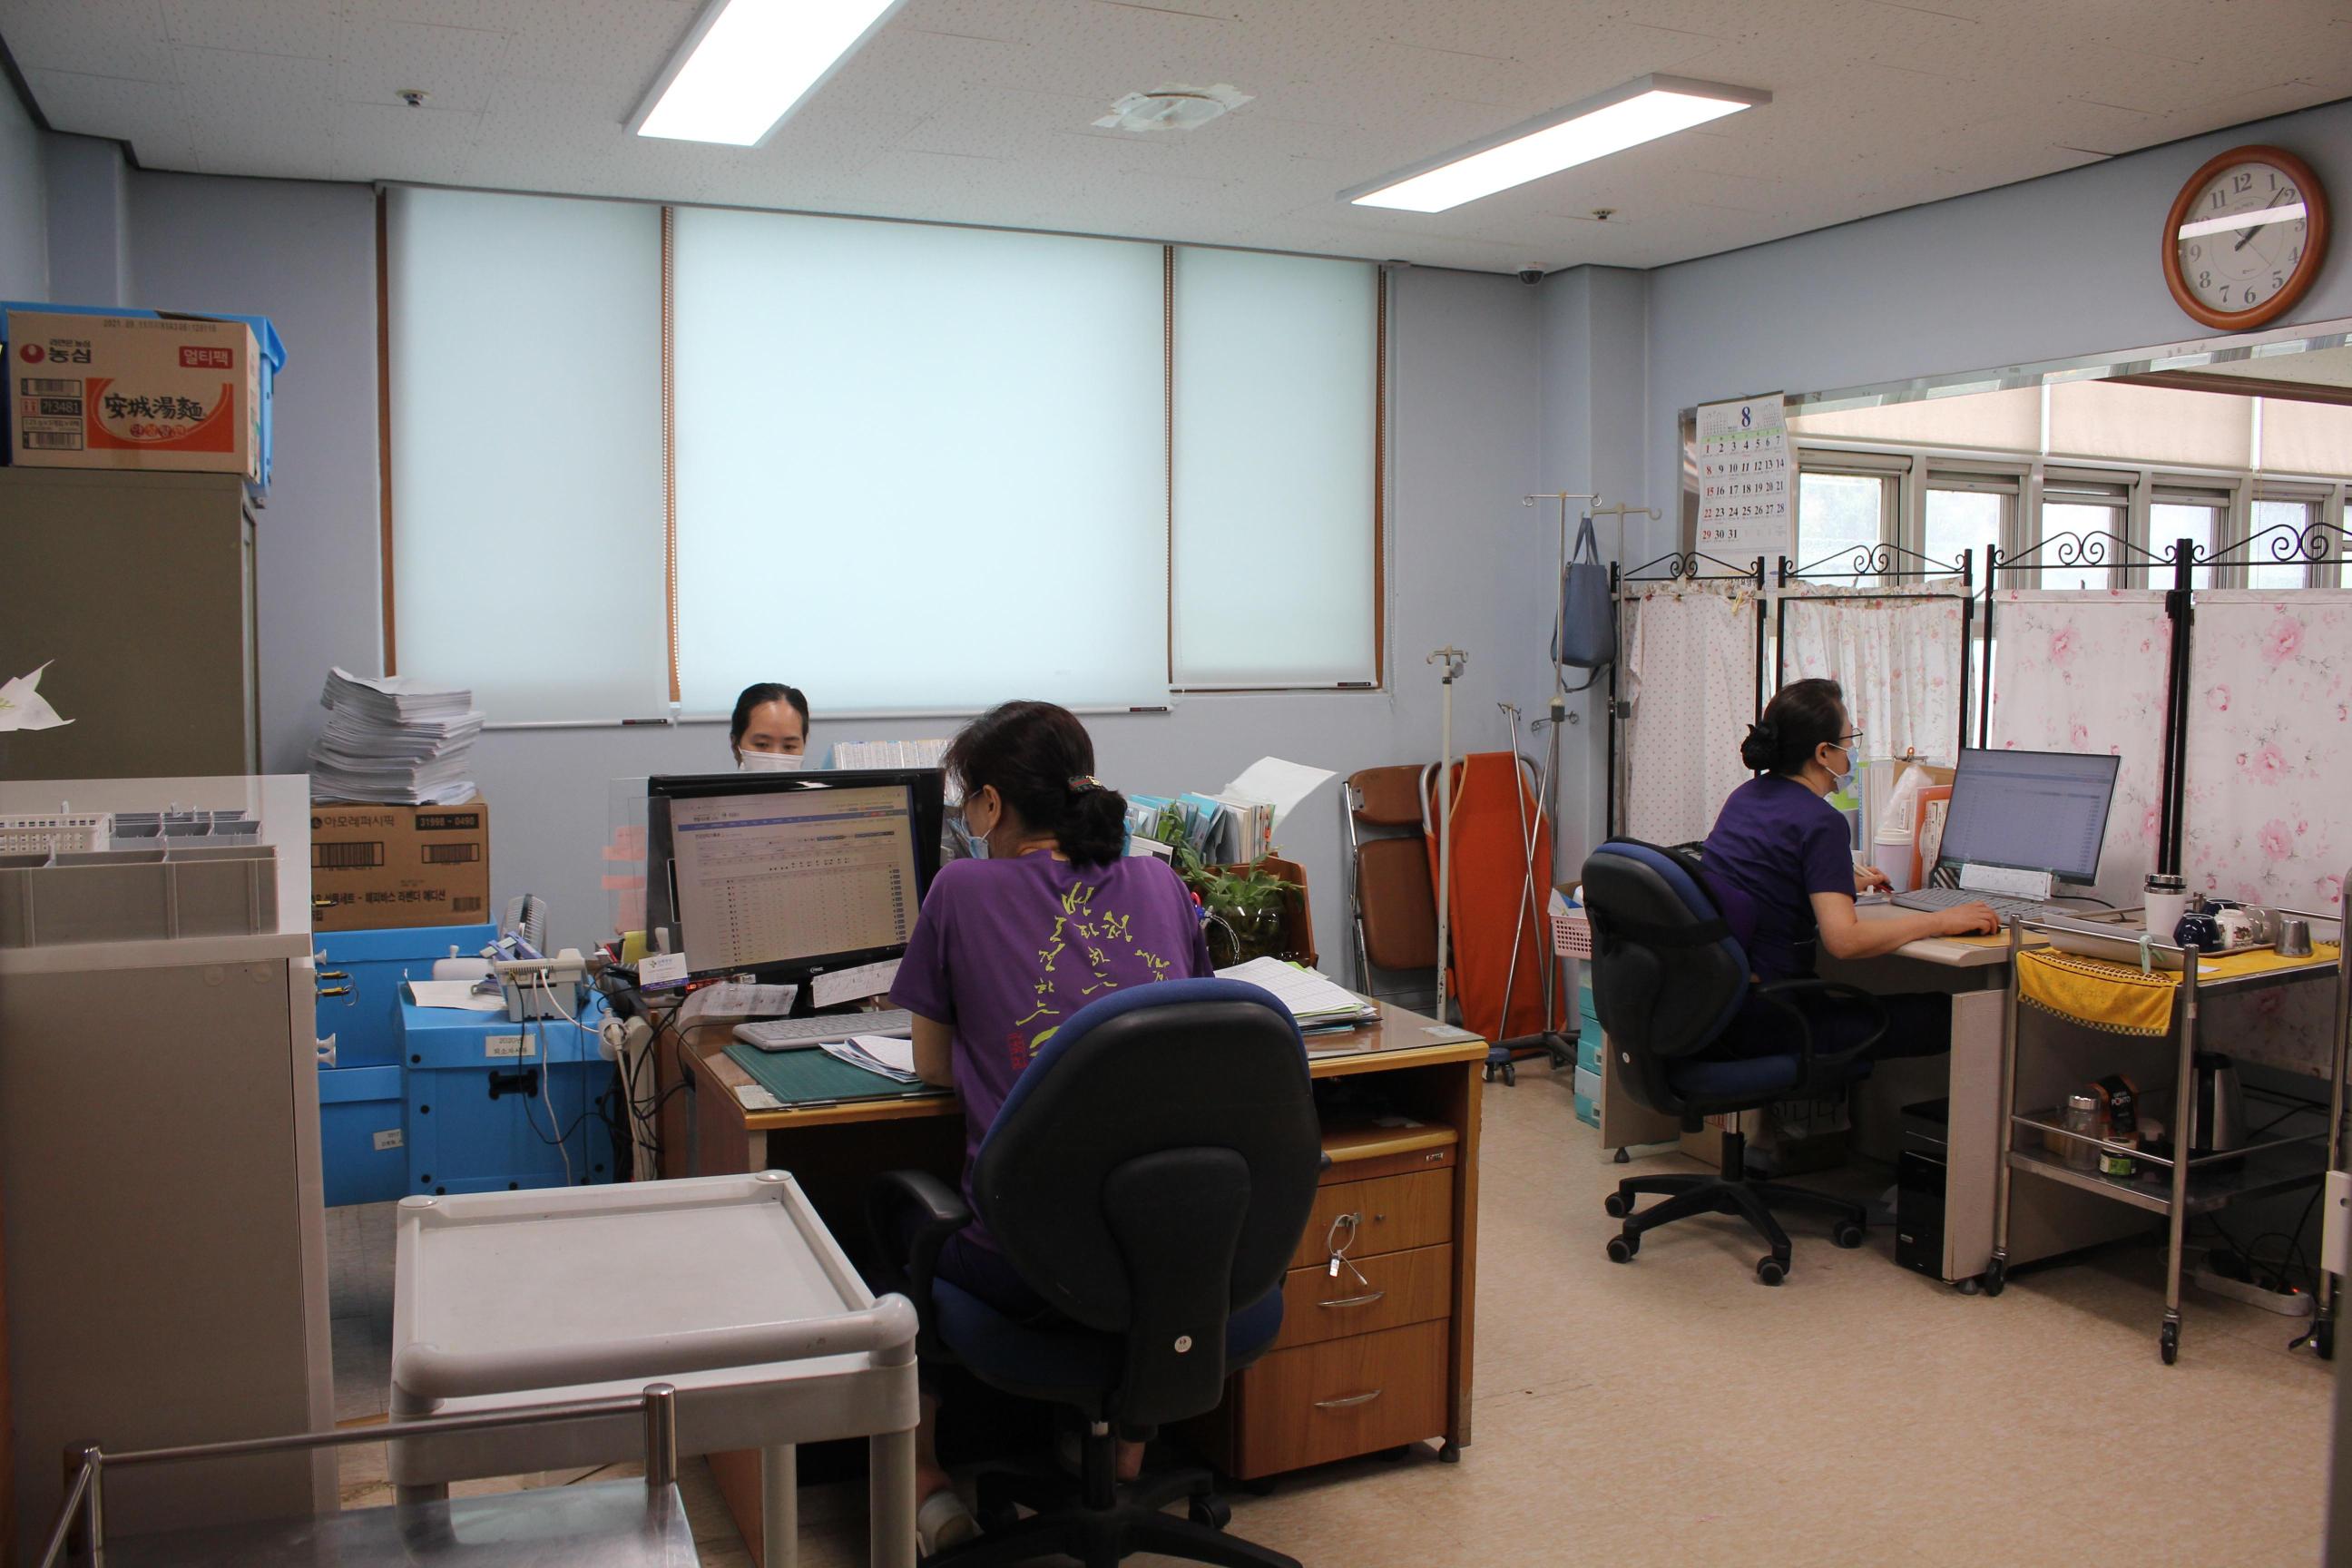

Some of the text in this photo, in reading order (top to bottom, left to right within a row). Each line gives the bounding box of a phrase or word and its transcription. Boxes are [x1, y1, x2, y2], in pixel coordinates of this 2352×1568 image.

[2233, 173, 2252, 194] 12
[2269, 173, 2276, 191] 1
[2211, 189, 2226, 211] 11
[2284, 189, 2296, 205] 2
[2295, 217, 2306, 232] 3
[2190, 245, 2201, 261] 9
[2288, 247, 2298, 264] 4
[2199, 271, 2211, 289] 8
[2272, 270, 2283, 289] 5
[2220, 285, 2230, 302] 7
[2244, 286, 2256, 304] 6
[48, 347, 92, 364] 농심
[183, 348, 229, 366] 멀티팩
[43, 400, 80, 414] 가3481
[104, 393, 204, 422] 安城湯麵
[1741, 407, 1750, 427] 8
[1706, 436, 1780, 454] 1 2 3 4 5 6 7
[1707, 458, 1784, 475] 8 9 10 11 12 13 14
[1707, 481, 1784, 496] 15 16 17 18 19 20 21
[1704, 503, 1785, 518] 22 23 24 25 26 27 28
[1702, 529, 1738, 540] 29 30 31
[324, 815, 394, 828] 아모레퍼시픽
